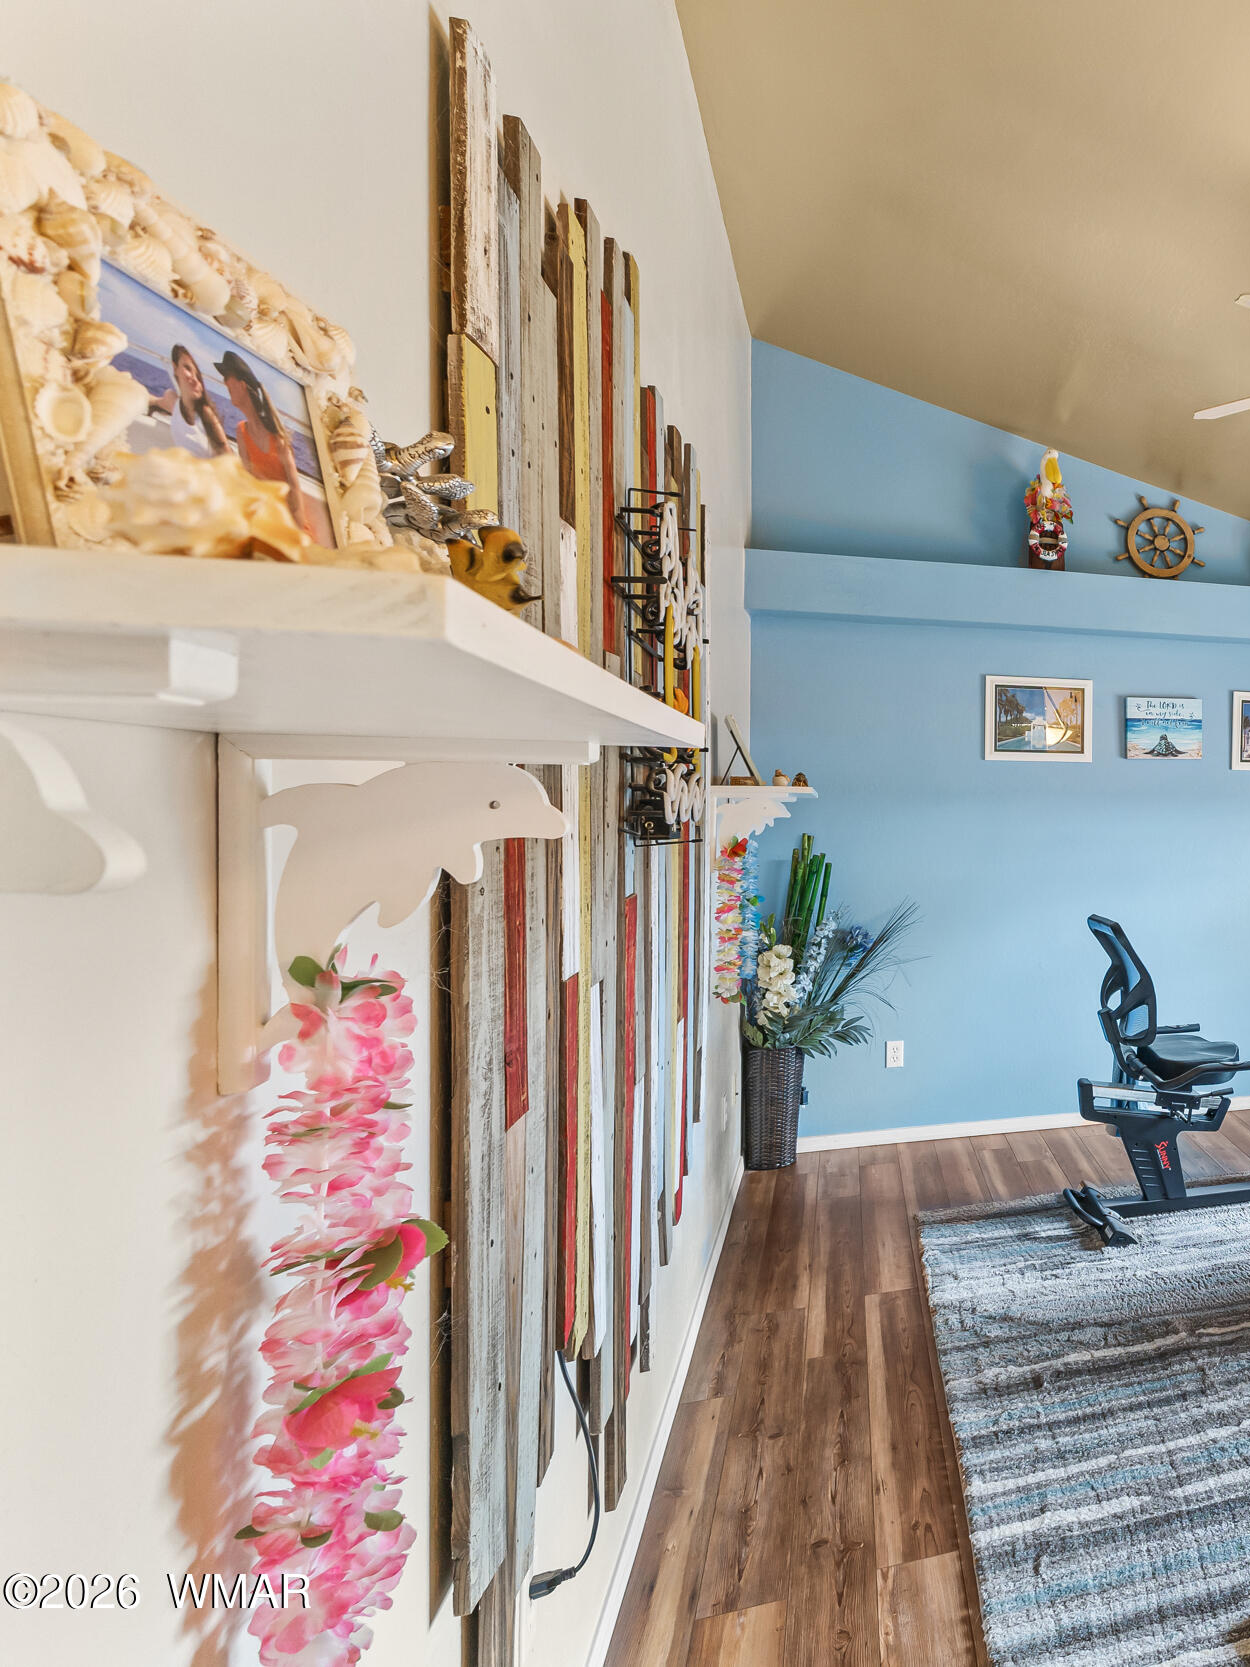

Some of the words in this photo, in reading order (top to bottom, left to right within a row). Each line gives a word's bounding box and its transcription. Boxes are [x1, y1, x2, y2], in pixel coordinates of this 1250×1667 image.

[1146, 700, 1156, 709] The
[1159, 701, 1177, 710] LORD
[1154, 1141, 1170, 1168] SUNNY
